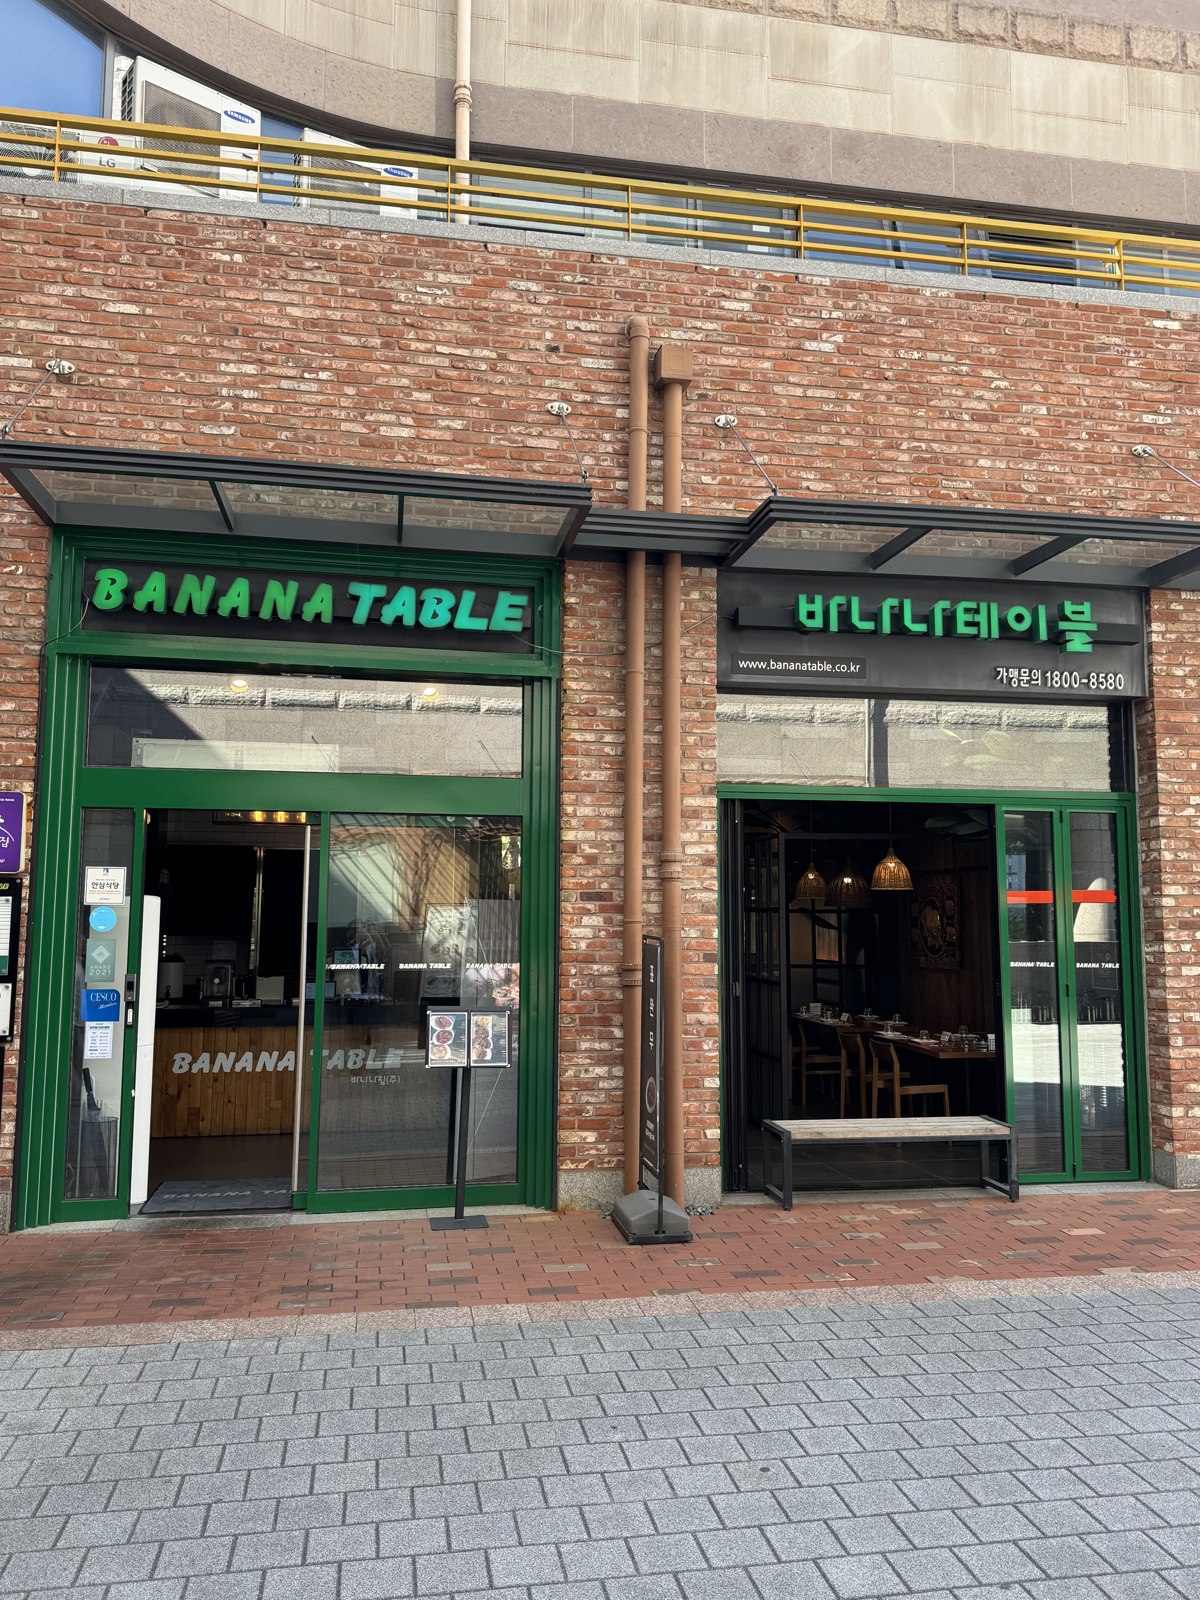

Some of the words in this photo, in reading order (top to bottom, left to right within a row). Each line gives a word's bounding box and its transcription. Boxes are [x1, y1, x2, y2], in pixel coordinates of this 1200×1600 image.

[99, 157, 116, 168] LG
[92, 567, 333, 625] BANANA
[348, 581, 529, 632] TABLE
[795, 593, 1098, 653] 바나나테이블
[738, 659, 860, 673] www.bananatable.co.kr
[996, 667, 1041, 687] 가맹문의
[1045, 670, 1124, 690] 1800-8580
[91, 881, 120, 890] 안심식당
[90, 992, 116, 1001] CESCO
[171, 1050, 296, 1074] BANANA
[350, 1075, 401, 1086] 바나나집(주)
